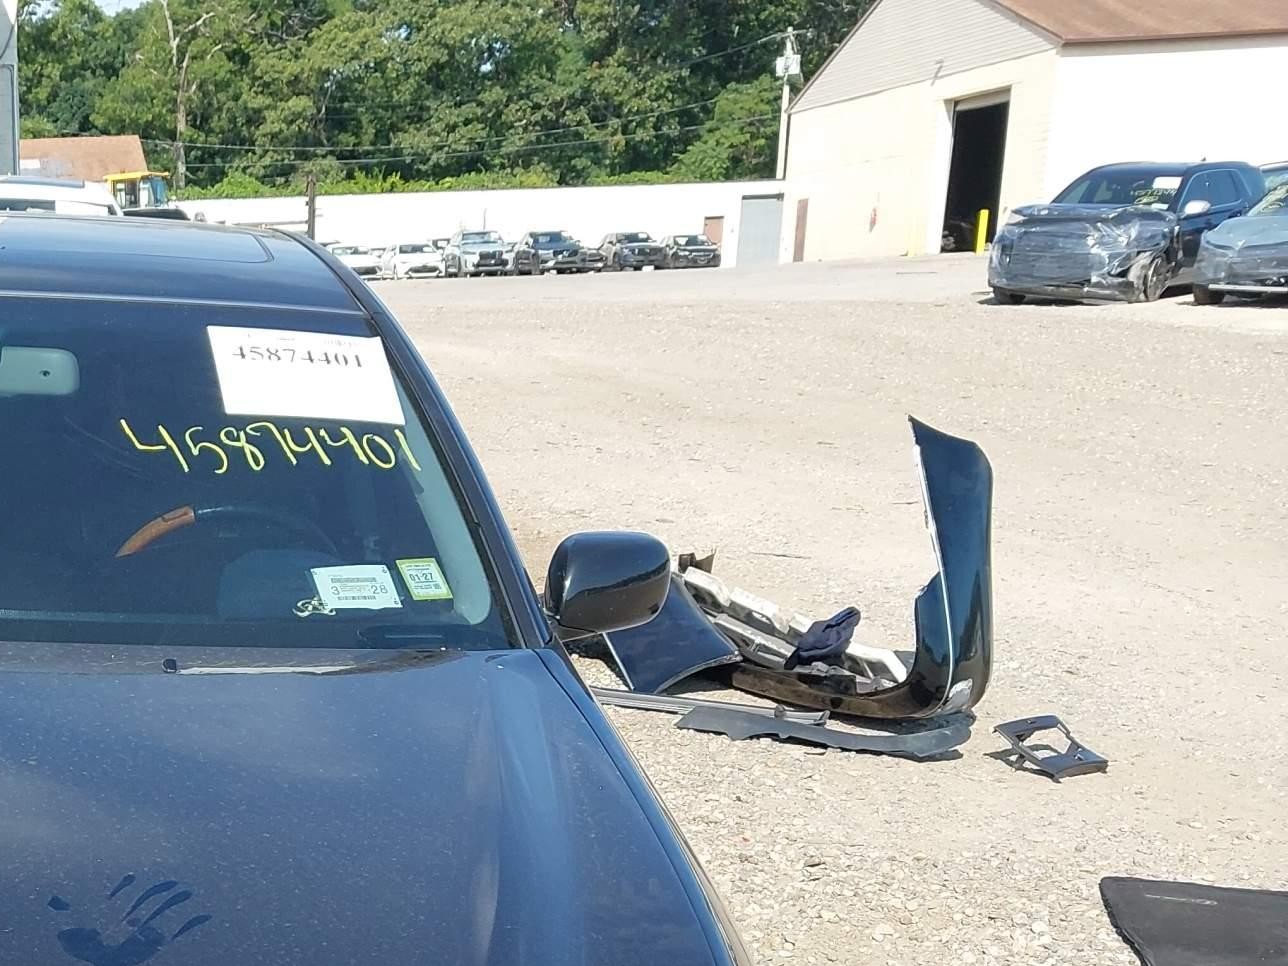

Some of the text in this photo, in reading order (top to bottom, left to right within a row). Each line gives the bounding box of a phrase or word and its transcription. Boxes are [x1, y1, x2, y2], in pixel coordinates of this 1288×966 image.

[231, 344, 363, 368] 45874401
[119, 418, 422, 474] 45874401
[330, 585, 340, 596] 3
[370, 584, 389, 595] 28
